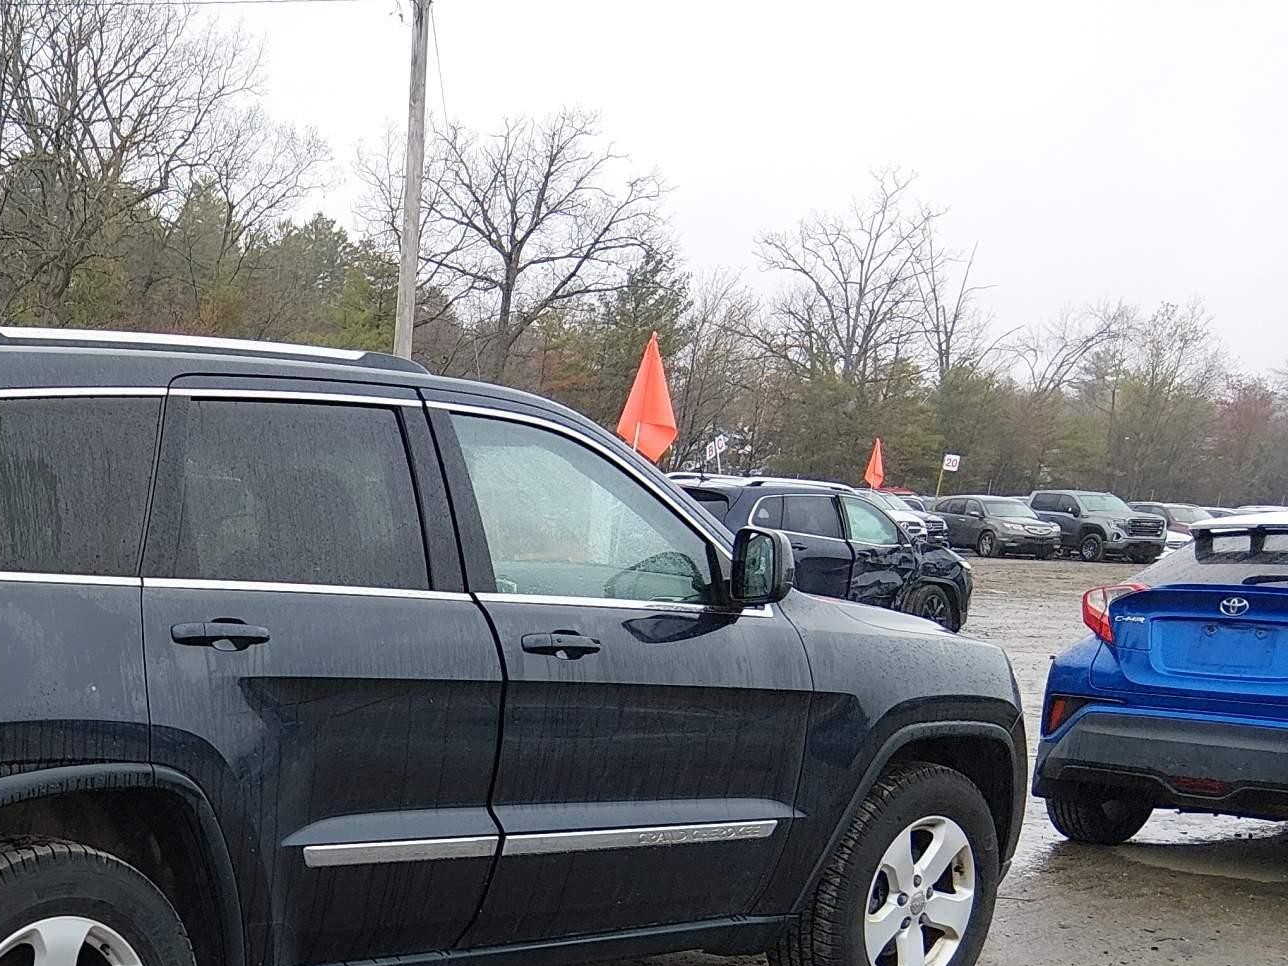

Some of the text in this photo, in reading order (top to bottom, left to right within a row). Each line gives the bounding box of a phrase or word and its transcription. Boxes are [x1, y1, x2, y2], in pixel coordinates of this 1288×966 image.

[945, 457, 958, 468] 20
[639, 824, 761, 845] GRAND CHEROKEE
